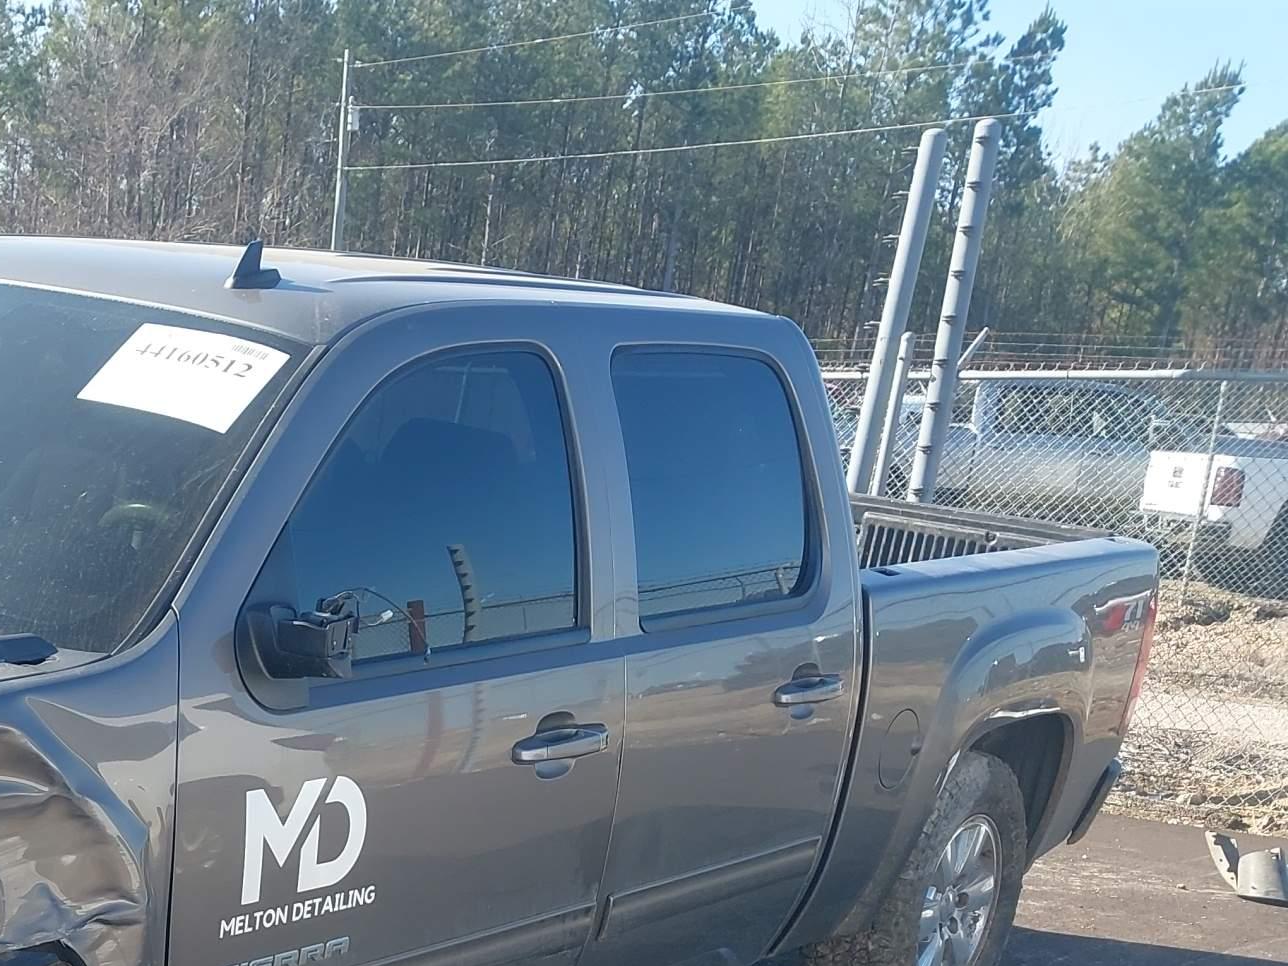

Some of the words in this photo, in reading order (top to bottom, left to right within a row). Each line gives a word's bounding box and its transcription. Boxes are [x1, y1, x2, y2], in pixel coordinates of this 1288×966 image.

[136, 343, 253, 378] 44160512
[241, 775, 367, 906] MD
[219, 904, 289, 939] MELTON
[291, 885, 376, 922] DETAILING
